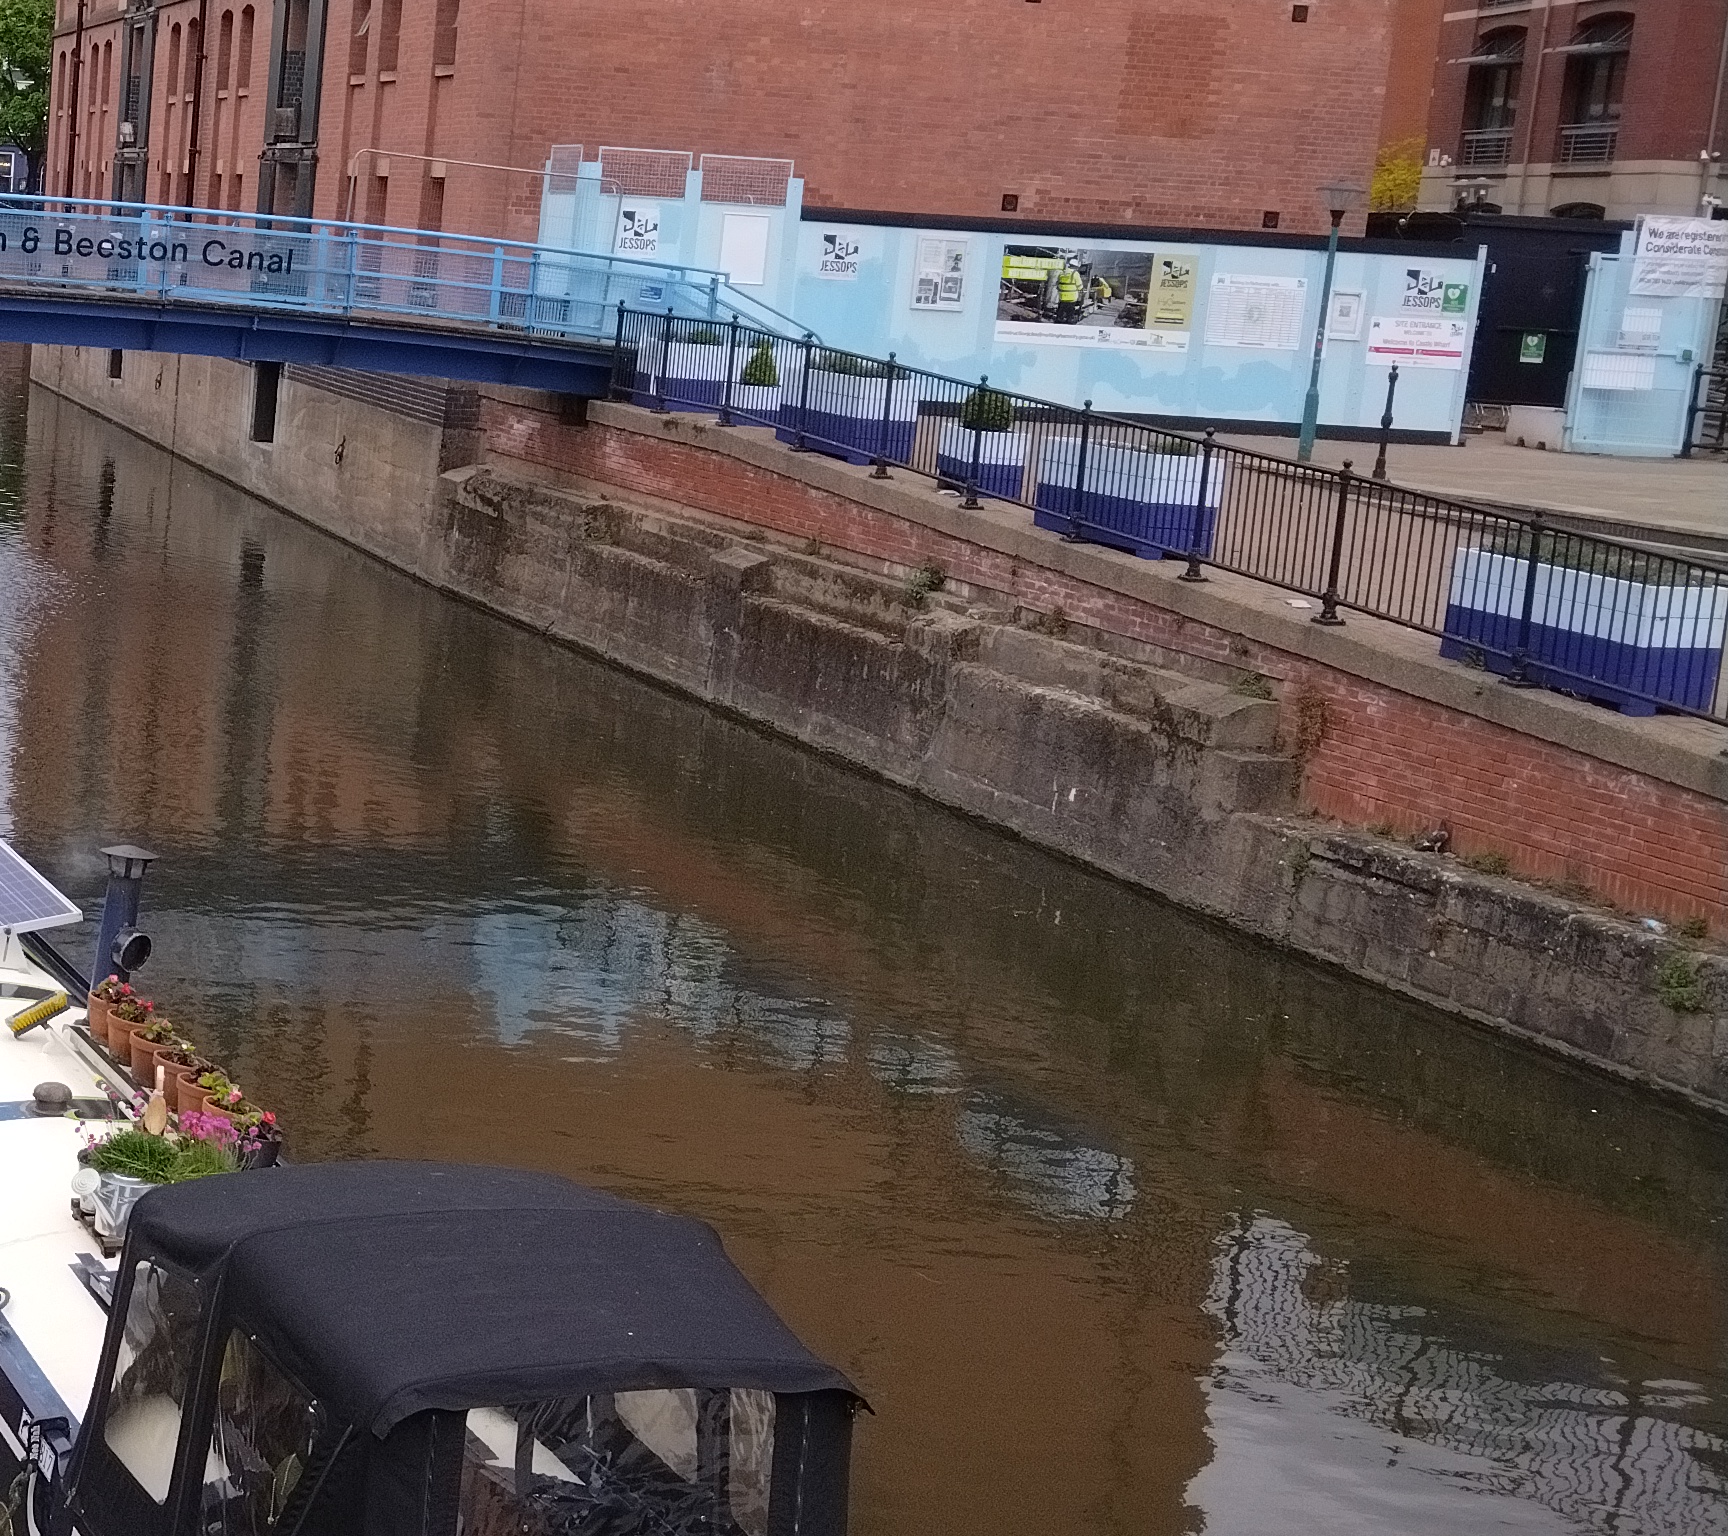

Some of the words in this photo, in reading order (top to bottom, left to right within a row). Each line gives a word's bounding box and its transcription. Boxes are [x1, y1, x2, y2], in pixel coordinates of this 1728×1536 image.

[1648, 227, 1664, 239] We
[1666, 230, 1680, 240] are
[619, 236, 657, 251] JESSOPS
[1645, 241, 1702, 256] Considerate
[21, 226, 40, 254] &
[54, 228, 188, 263] Beeston
[202, 239, 294, 276] Canal
[820, 260, 858, 274] JESSOPS
[1402, 295, 1442, 309] JESSOPS
